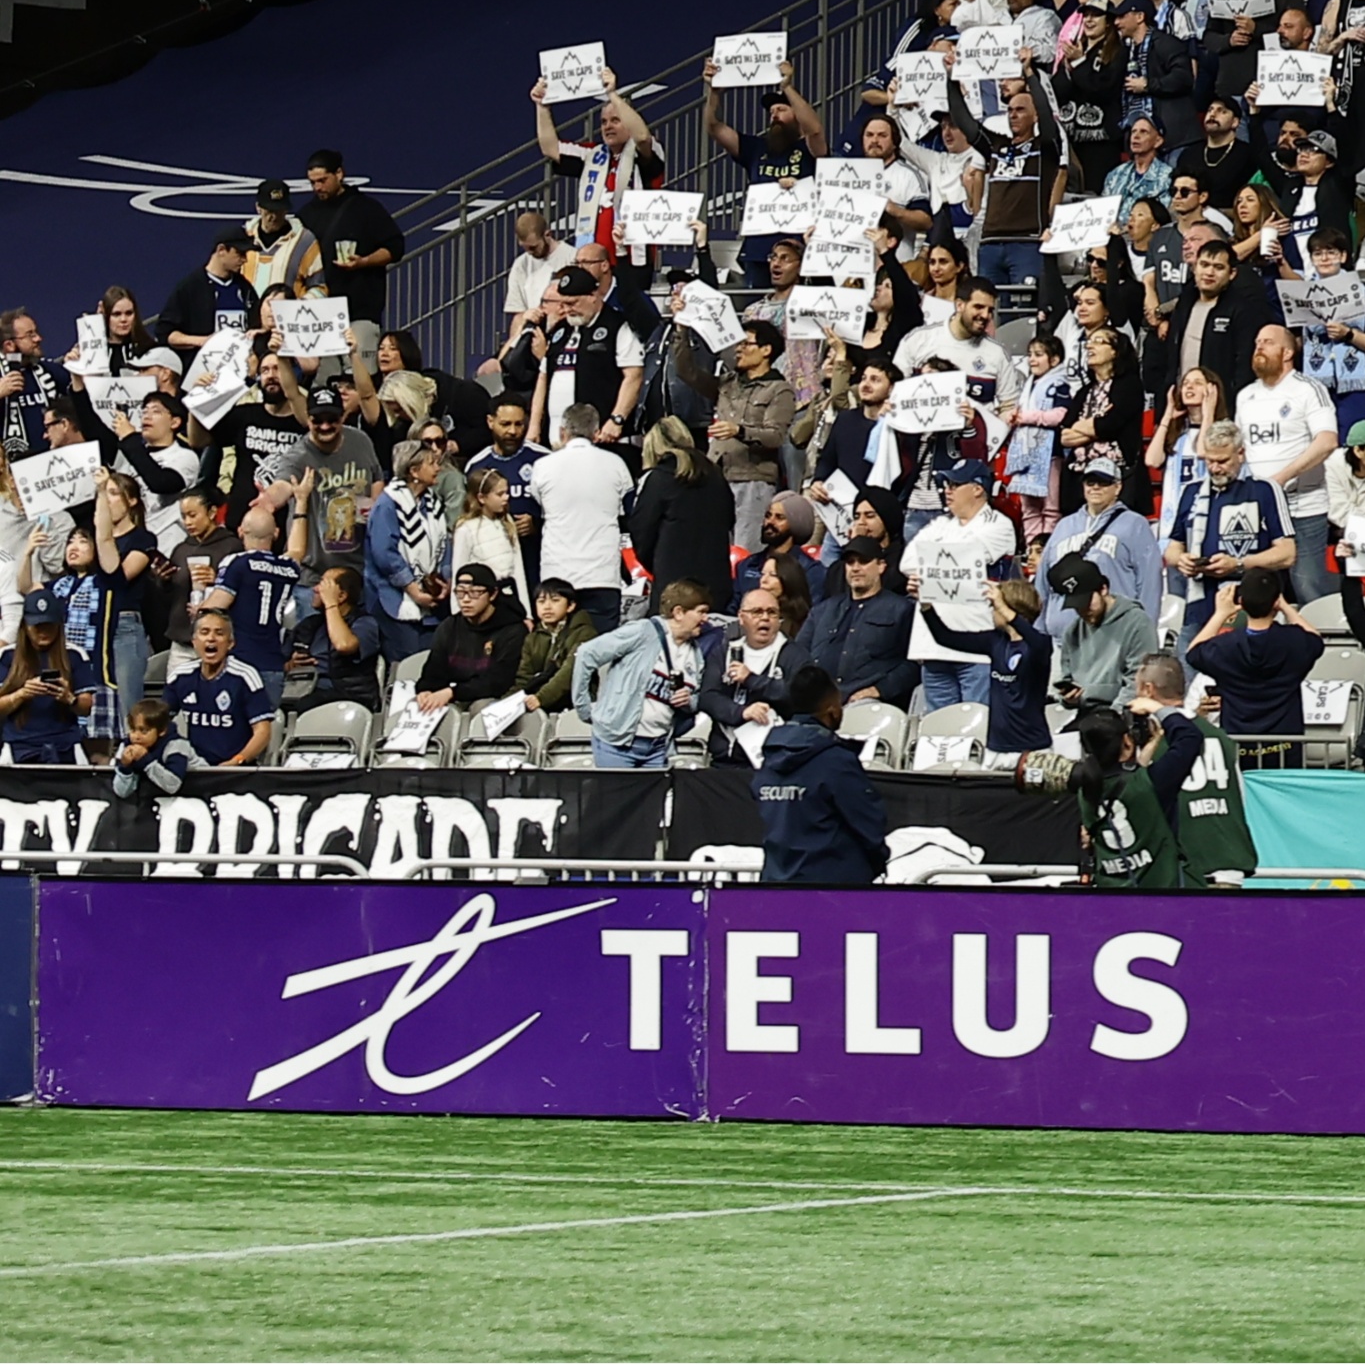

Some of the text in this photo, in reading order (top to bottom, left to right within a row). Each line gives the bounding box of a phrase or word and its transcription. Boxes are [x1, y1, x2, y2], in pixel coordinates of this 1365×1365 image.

[758, 164, 800, 176] TELUS
[1161, 259, 1187, 283] Bell
[248, 425, 276, 440] RAIN
[1249, 423, 1280, 445] Bell
[246, 438, 293, 455] BRIGA
[34, 478, 53, 492] SAVE
[65, 468, 86, 482] CAPS
[181, 709, 233, 728] TELUS
[601, 929, 1188, 1061] TELUS
